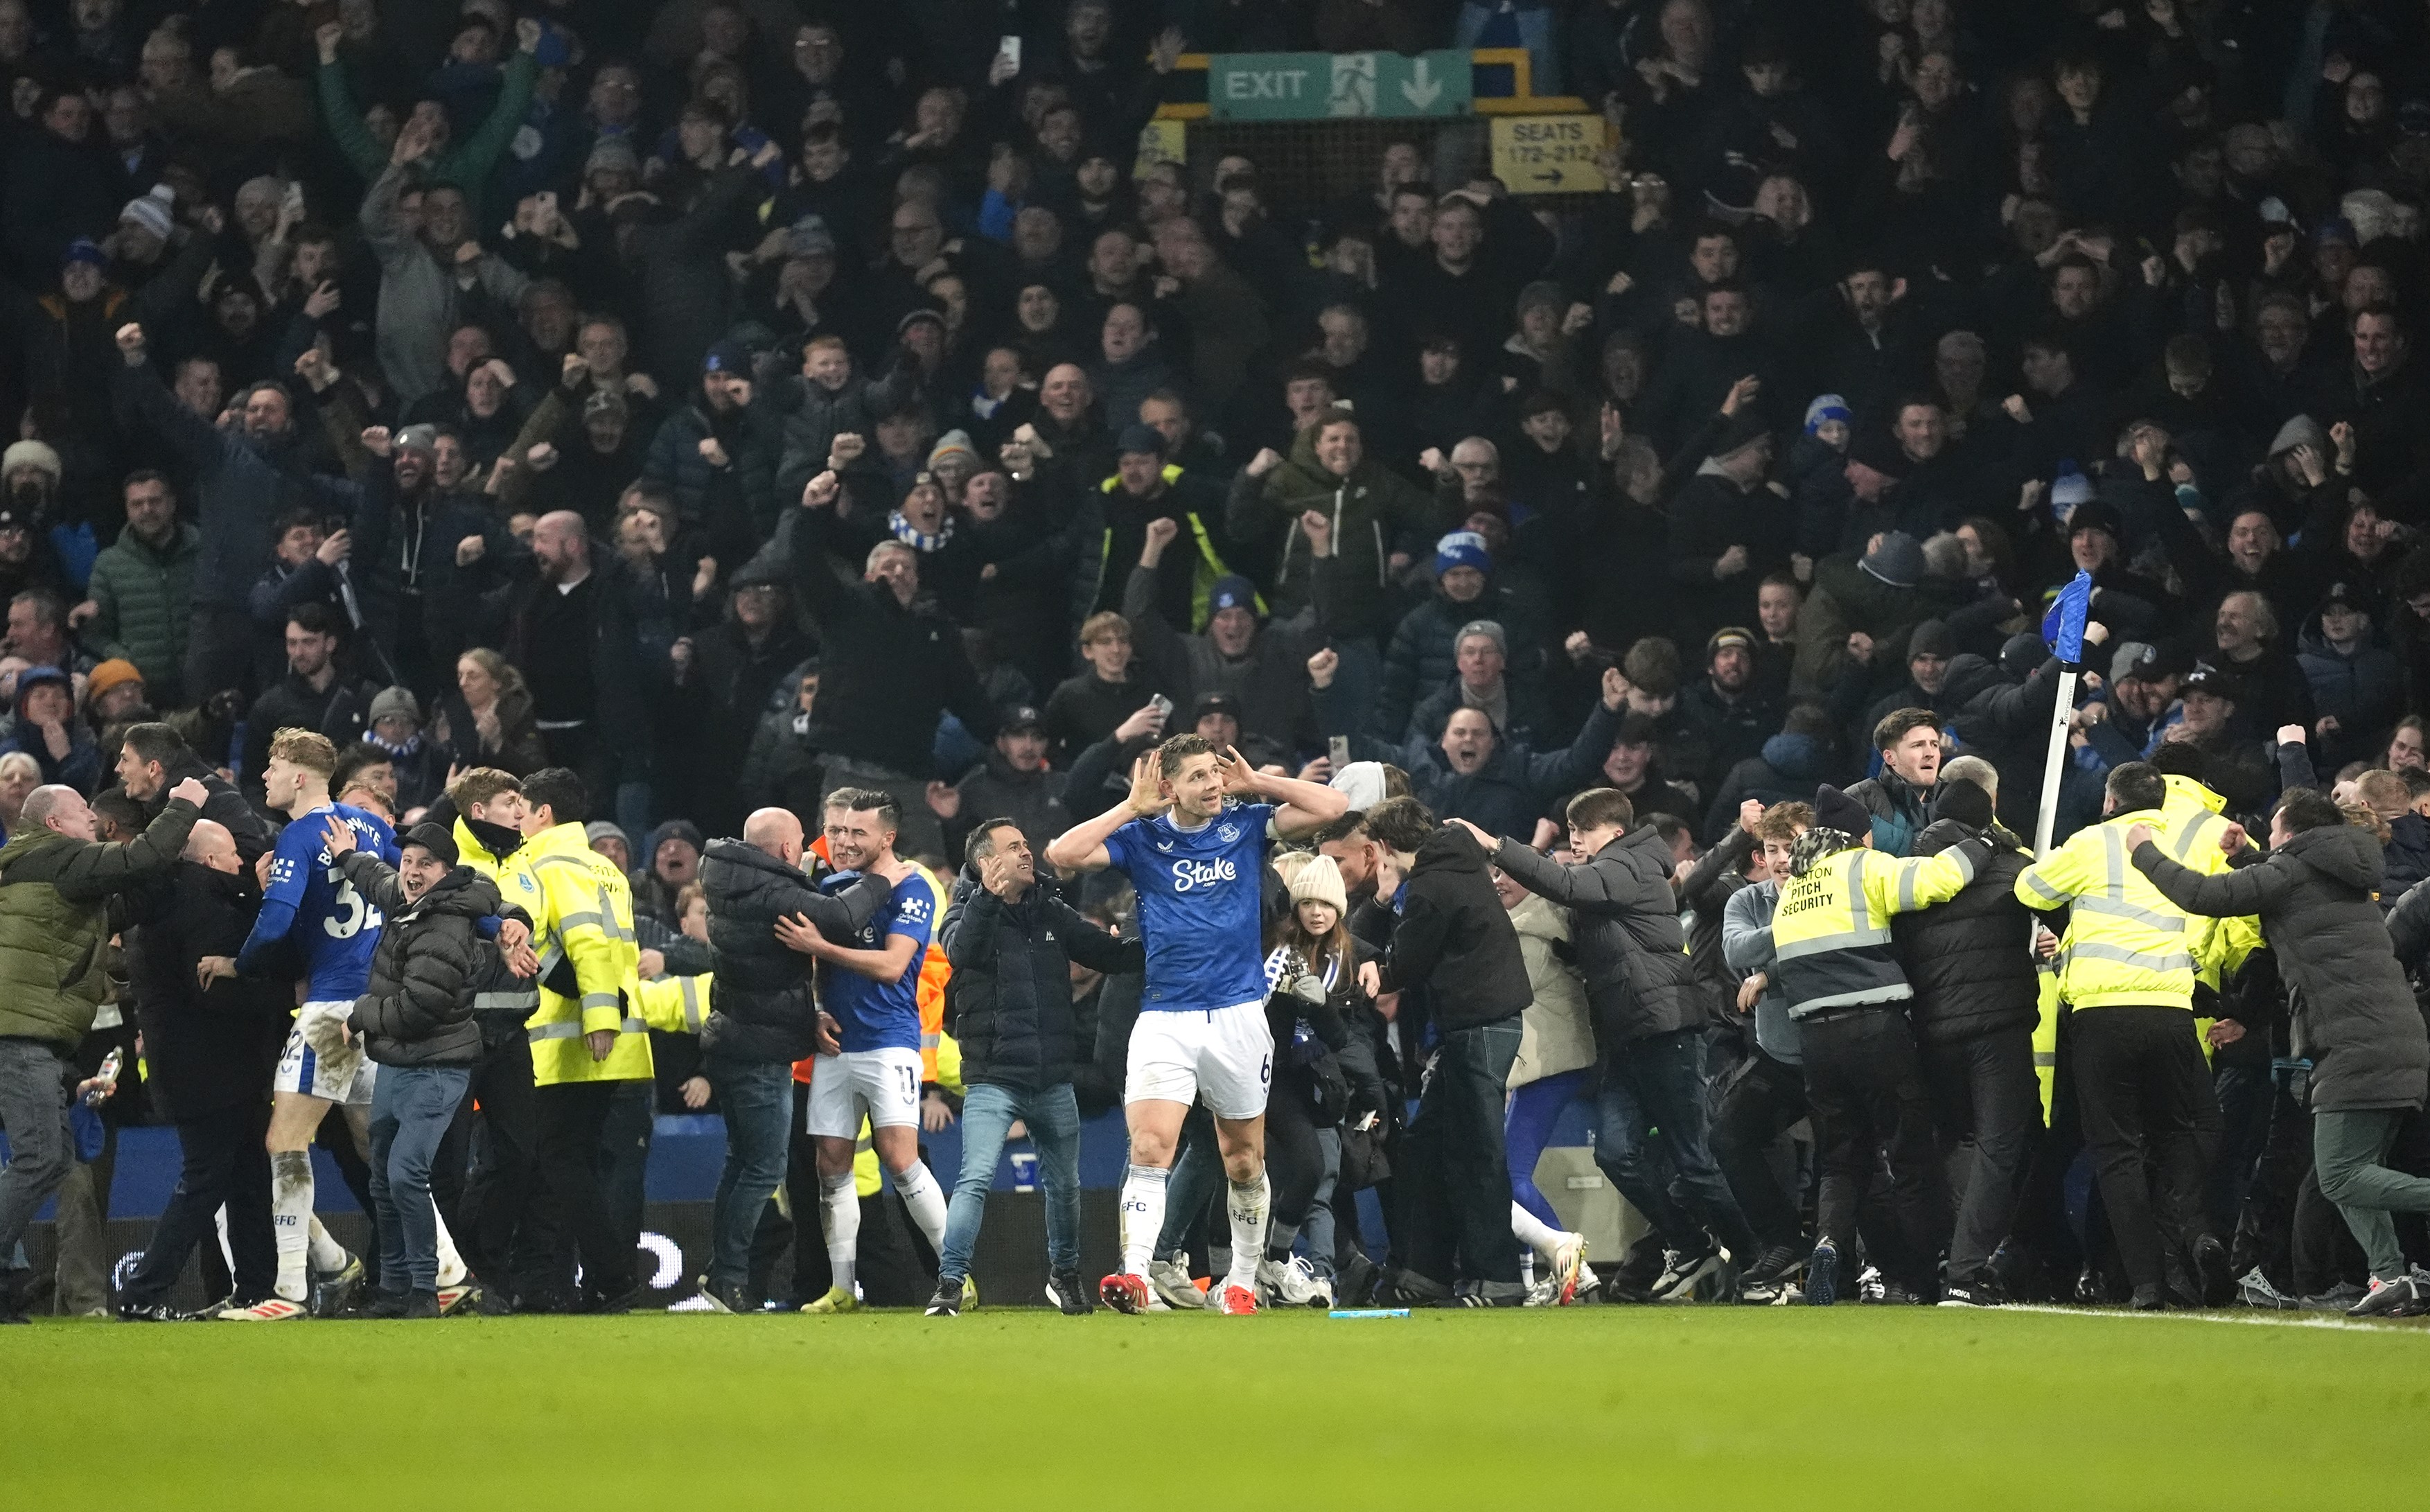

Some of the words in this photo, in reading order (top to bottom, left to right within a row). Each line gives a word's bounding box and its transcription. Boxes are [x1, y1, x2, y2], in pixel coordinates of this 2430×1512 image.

[1226, 70, 1308, 99] EXIT
[1513, 123, 1583, 141] SEATS
[1172, 857, 1236, 892] Stake
[1791, 881, 1821, 899] PITCH
[1781, 893, 1833, 917] SECURITY
[1260, 1053, 1270, 1084] 6
[895, 1065, 915, 1093] 11
[1121, 1201, 1147, 1212] EFC
[274, 1215, 297, 1226] EFC
[1233, 1208, 1258, 1225] EFC
[1948, 1287, 1971, 1300] HOKA
